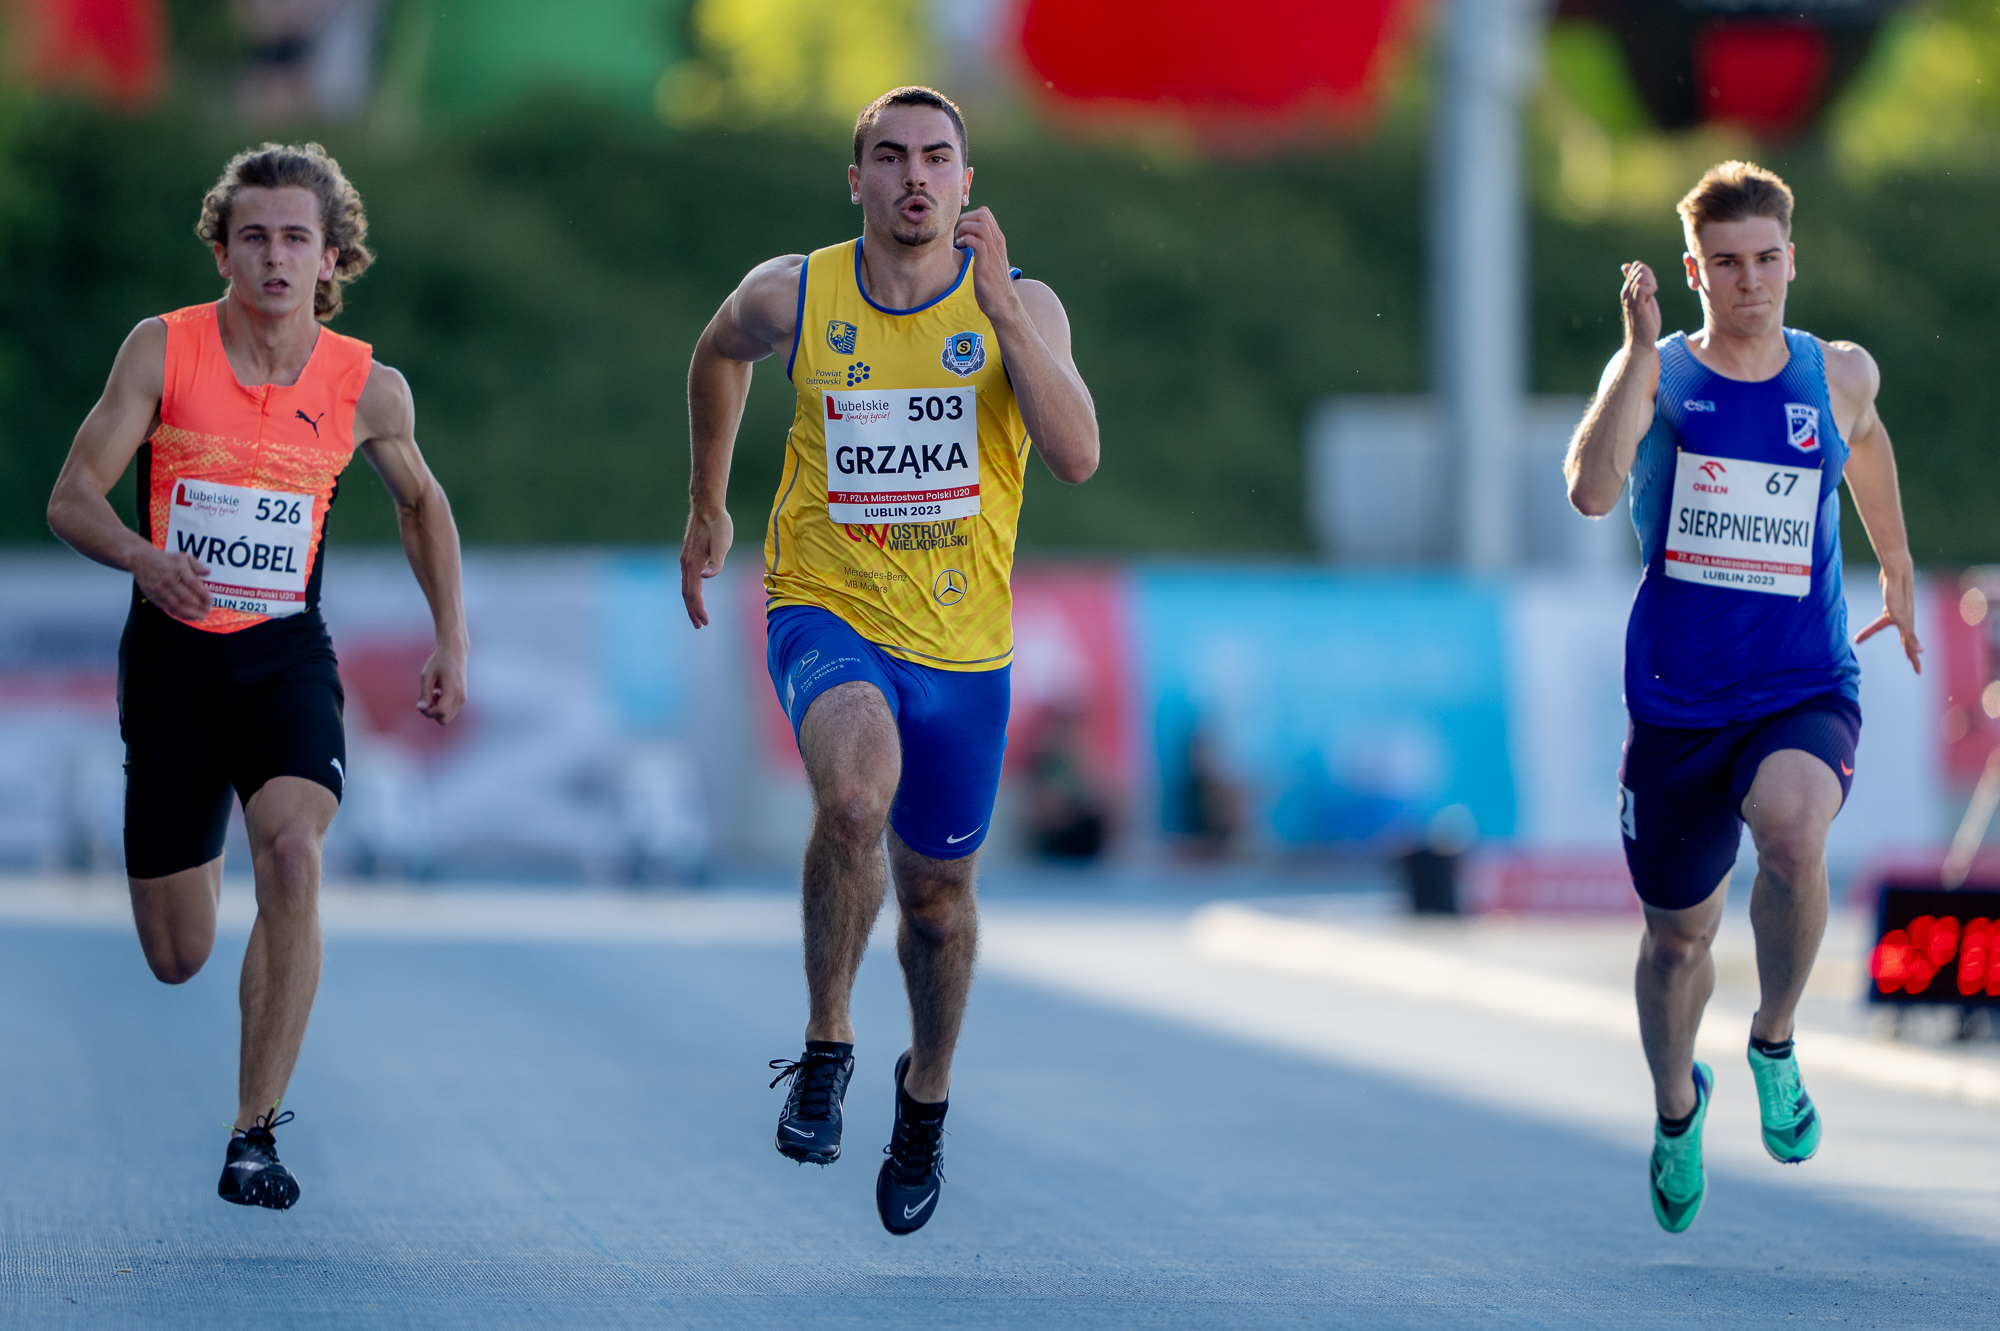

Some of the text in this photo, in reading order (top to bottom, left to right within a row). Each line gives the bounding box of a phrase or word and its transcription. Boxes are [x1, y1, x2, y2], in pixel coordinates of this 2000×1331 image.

[806, 377, 841, 385] Ostrowski
[815, 369, 842, 377] Powiat
[908, 395, 963, 422] 503
[836, 442, 969, 479] GRZĄKA
[1693, 483, 1728, 494] ORLEN
[1766, 472, 1799, 496] 67
[838, 488, 970, 503] 77. PZLA Mistrzostwa Polski U20
[255, 497, 301, 525] 526
[864, 505, 942, 518] LUBLIN 2023
[891, 520, 956, 540] OSTRÓW
[1678, 507, 1809, 548] SIERPNIEWSKI
[888, 535, 968, 551] WIELKOPOLSKI
[177, 530, 298, 574] WRÓBEL
[1690, 555, 1710, 565] PZLA
[1711, 558, 1761, 571] Mistrzostwa
[1763, 563, 1786, 573] Polski
[1787, 565, 1804, 575] U20
[844, 566, 908, 582] Mercedes-Benz
[1703, 570, 1776, 586] LUBLIN 2023
[204, 583, 296, 600] Mistrzostwa Polski U20
[845, 579, 888, 594] MB Motors
[240, 601, 268, 613] 2023
[801, 657, 861, 690] Mercedes-Benz
[814, 664, 845, 680] Motors
